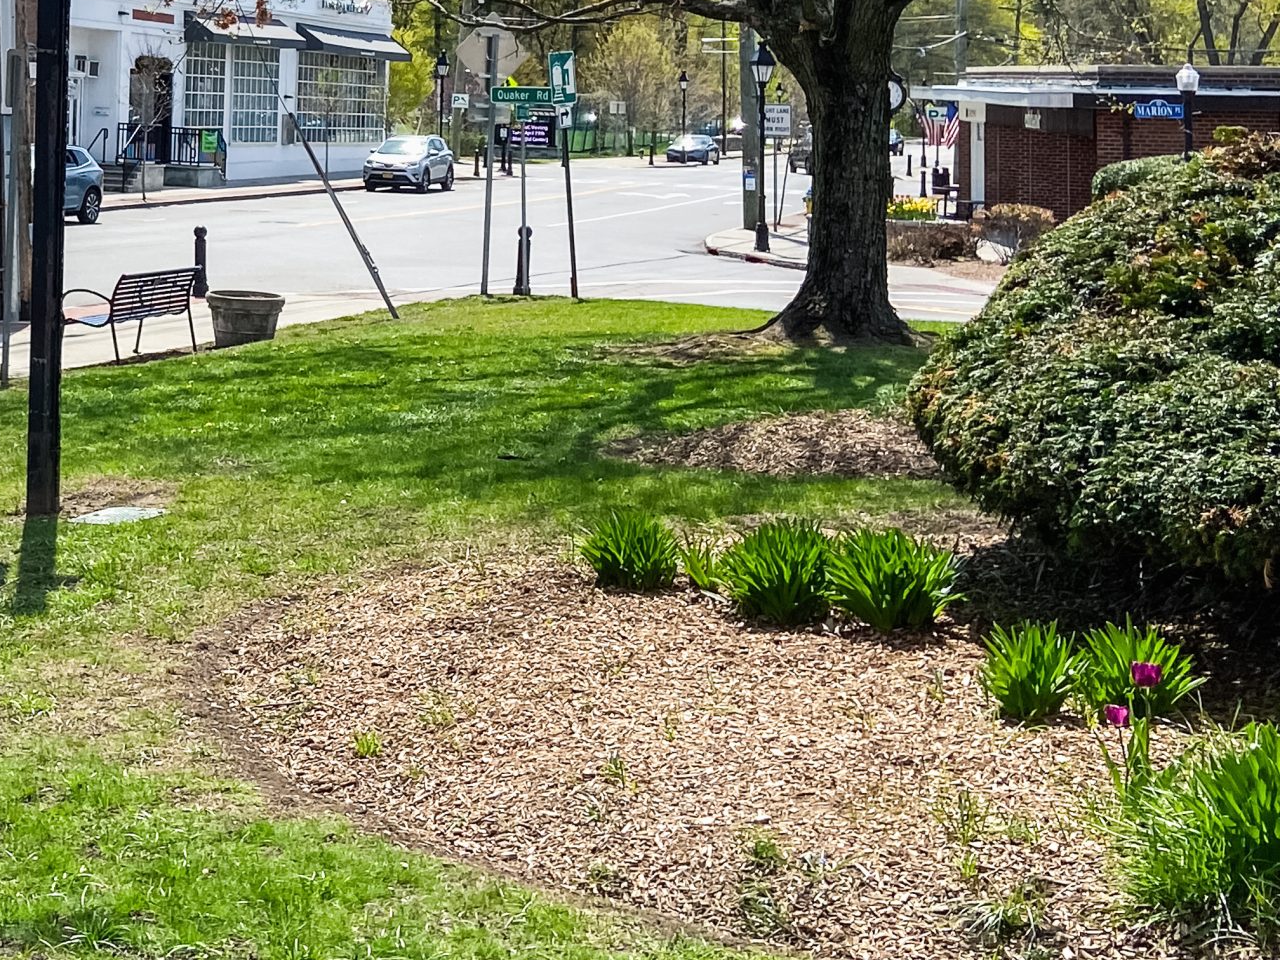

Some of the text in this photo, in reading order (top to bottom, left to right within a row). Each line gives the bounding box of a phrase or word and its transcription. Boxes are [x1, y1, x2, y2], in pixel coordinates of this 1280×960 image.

[497, 89, 549, 101] Quaker Rd
[1136, 105, 1173, 116] MARION
